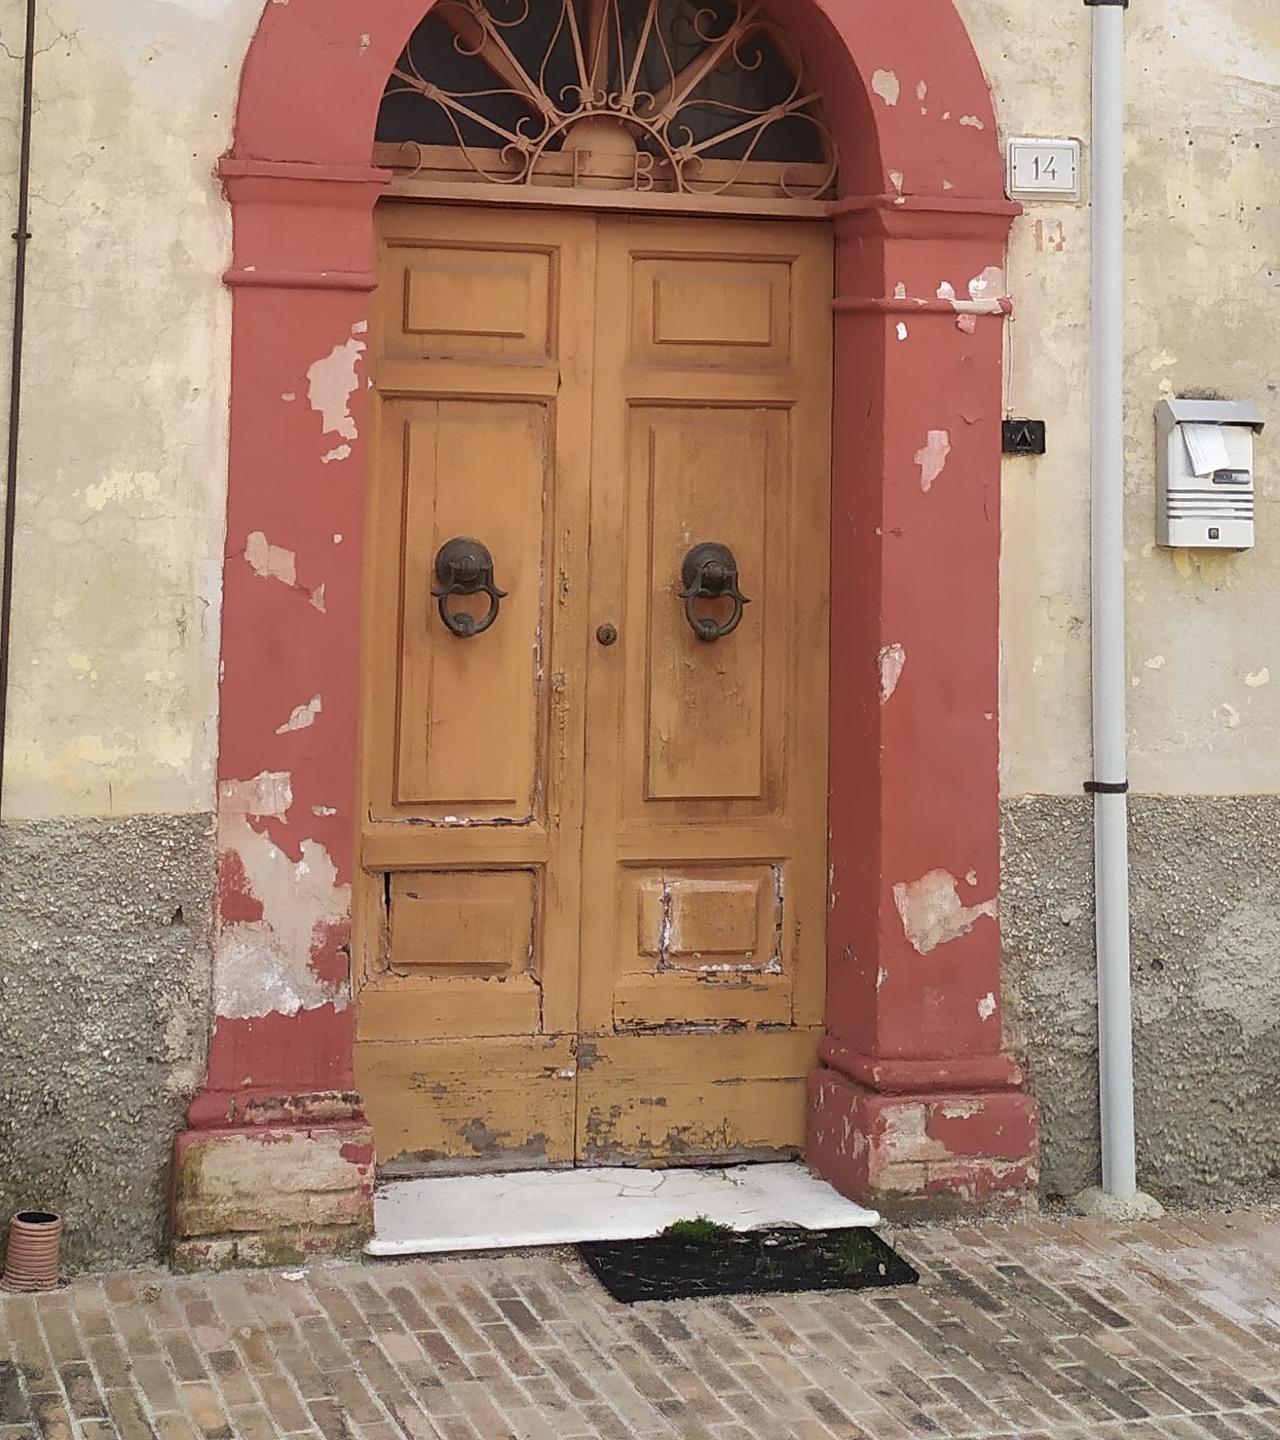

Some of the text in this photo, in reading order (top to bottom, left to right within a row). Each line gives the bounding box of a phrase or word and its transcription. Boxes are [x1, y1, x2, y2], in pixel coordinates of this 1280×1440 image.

[634, 151, 655, 192] B
[1032, 156, 1057, 181] 14
[1031, 219, 1066, 252] 14
